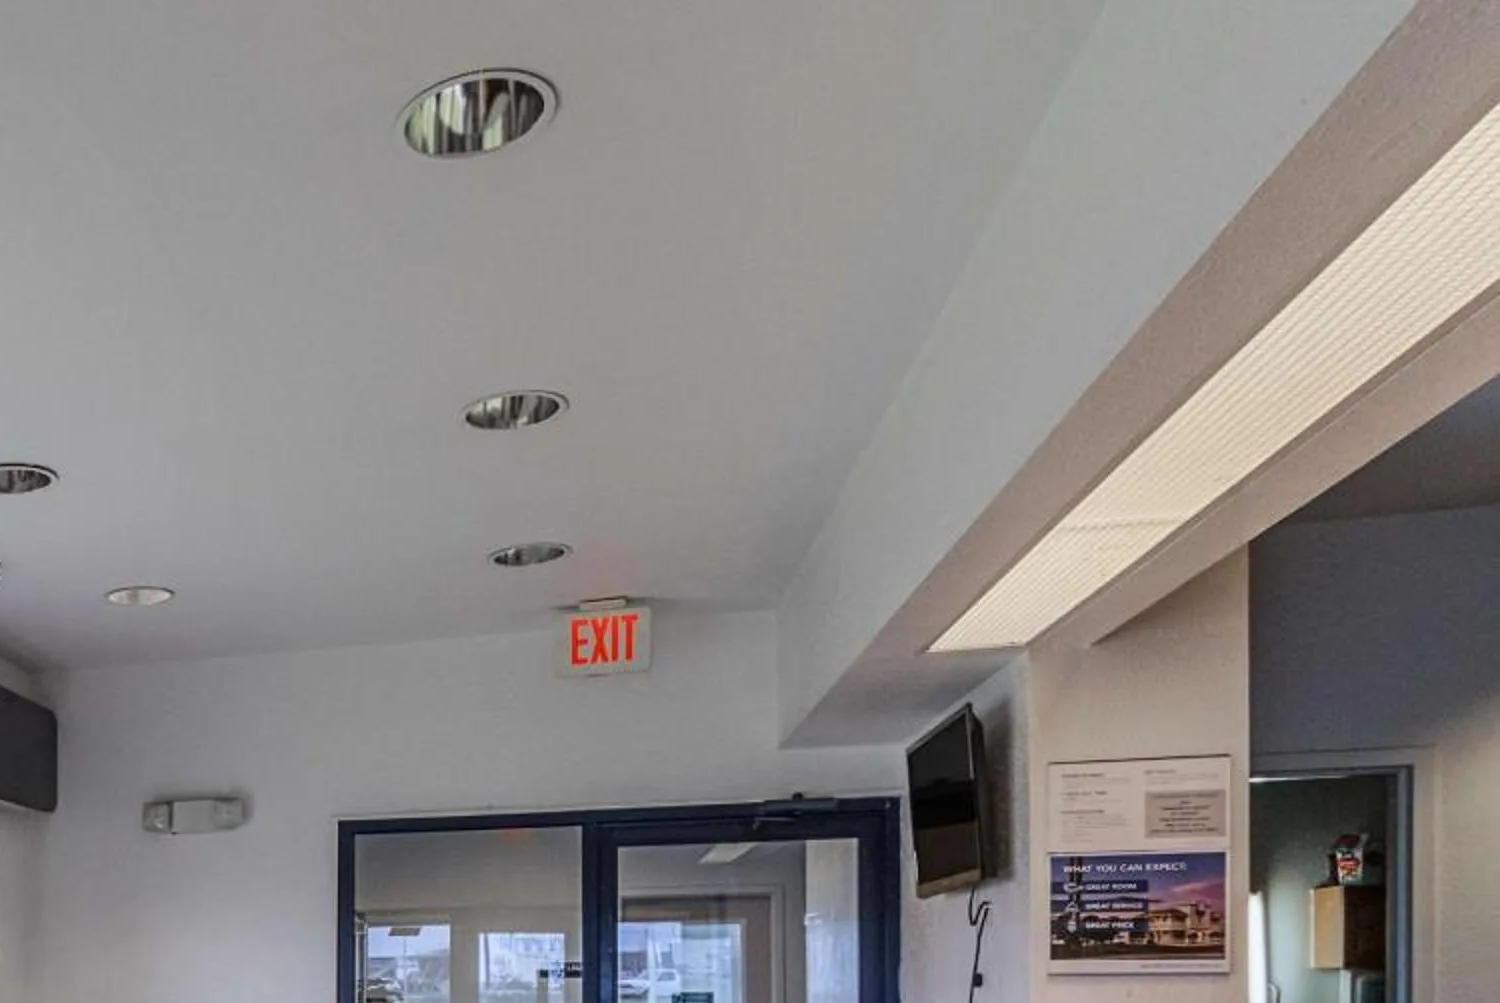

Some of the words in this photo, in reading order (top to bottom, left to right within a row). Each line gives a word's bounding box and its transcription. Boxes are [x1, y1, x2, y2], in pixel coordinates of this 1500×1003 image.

[571, 612, 639, 665] EXIT
[1063, 864, 1091, 873] WHAT
[1096, 863, 1117, 873] YOU
[1120, 863, 1143, 873] CAN
